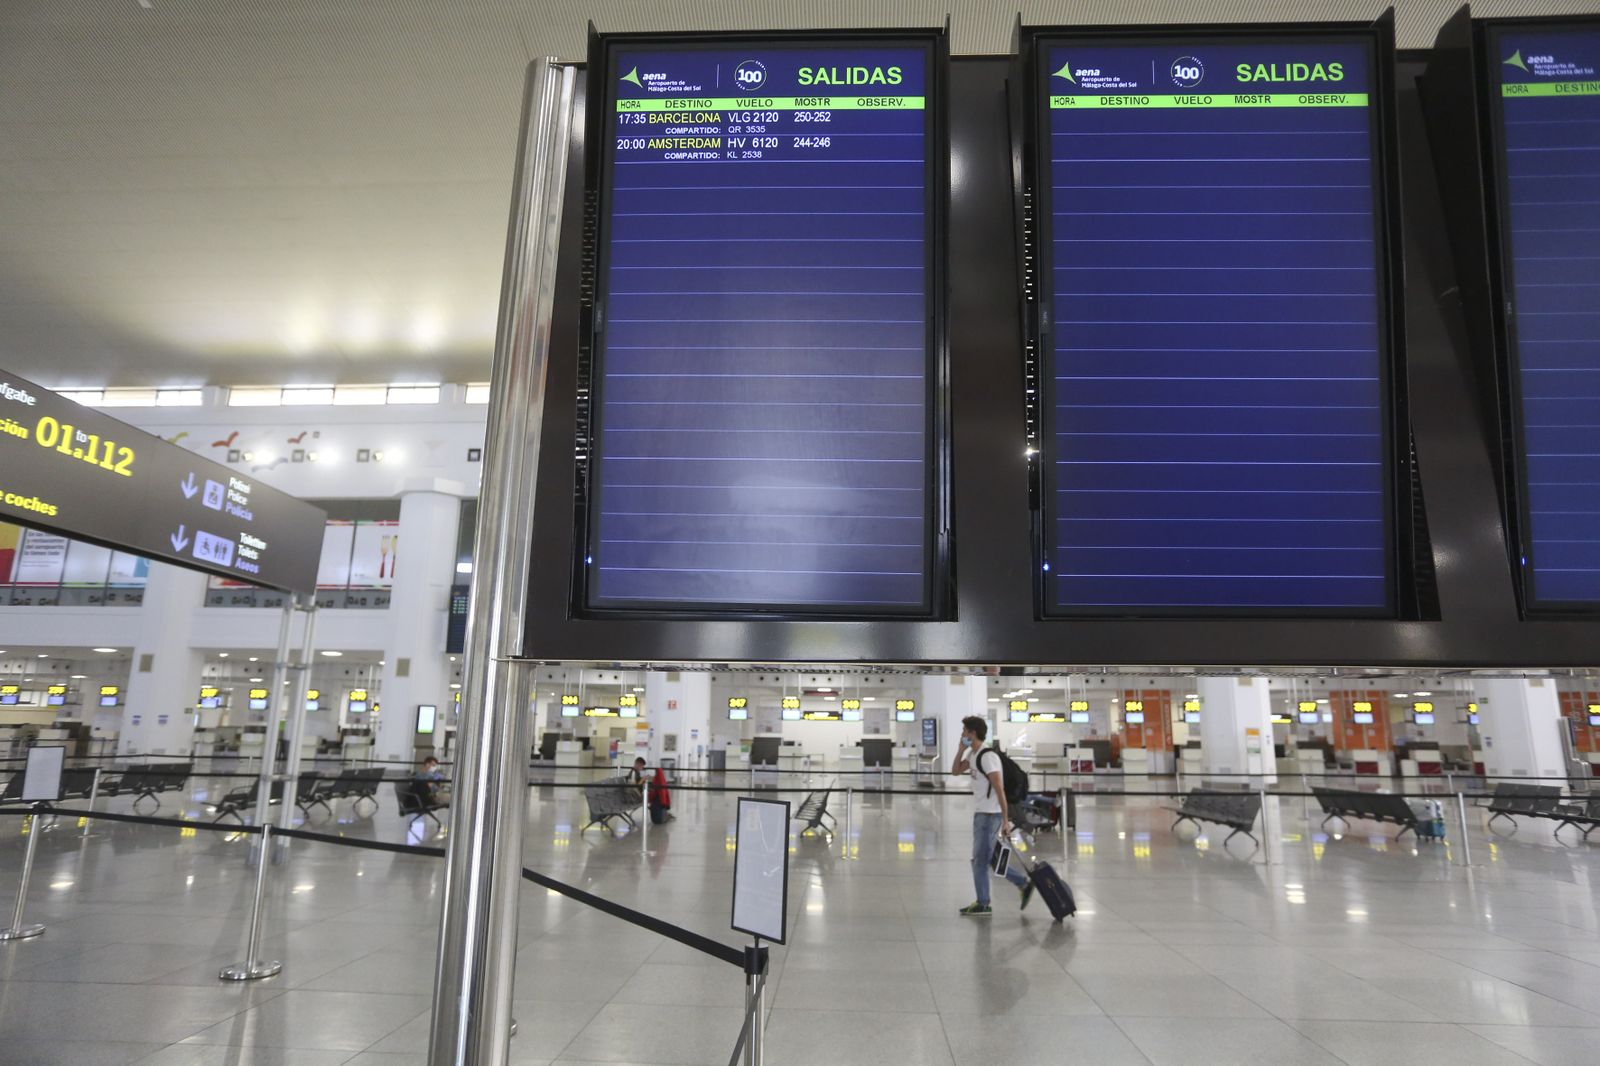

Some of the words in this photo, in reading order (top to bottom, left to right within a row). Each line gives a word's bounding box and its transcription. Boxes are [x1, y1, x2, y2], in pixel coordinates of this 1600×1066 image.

[1528, 55, 1553, 64] aena
[643, 72, 666, 80] aena
[738, 68, 762, 83] 100
[798, 67, 902, 85] SALIDAS
[1076, 68, 1100, 76] aena
[1174, 65, 1198, 79] 100
[1236, 63, 1344, 82] SALIDAS
[1506, 85, 1528, 93] HORA
[620, 101, 641, 109] HORA
[665, 99, 712, 108] DESTINO
[736, 98, 773, 108] VUELO
[795, 98, 830, 106] MOSTR
[858, 98, 906, 107] OBSERV.
[1054, 96, 1075, 105] HORA
[1101, 96, 1149, 105] DESTINO
[1174, 95, 1212, 105] VUELO
[1235, 95, 1271, 104] MOSTR
[1299, 95, 1349, 104] OBSERV.
[618, 113, 646, 124] 17:35
[649, 112, 721, 123] BARCELONA
[728, 112, 751, 123] VLG
[753, 112, 778, 123] 2120
[794, 112, 830, 122] 250-252
[617, 139, 645, 149] 20:00
[648, 138, 721, 148] AMSTERDAM
[728, 137, 746, 148] HV
[752, 137, 778, 148] 6120
[794, 137, 830, 148] 244-246
[76, 430, 88, 442] to
[36, 416, 73, 455] 01
[74, 448, 84, 459] a
[84, 434, 135, 477] 112
[227, 489, 248, 506] Police
[5, 492, 58, 516] coches
[235, 557, 260, 574] Aseos
